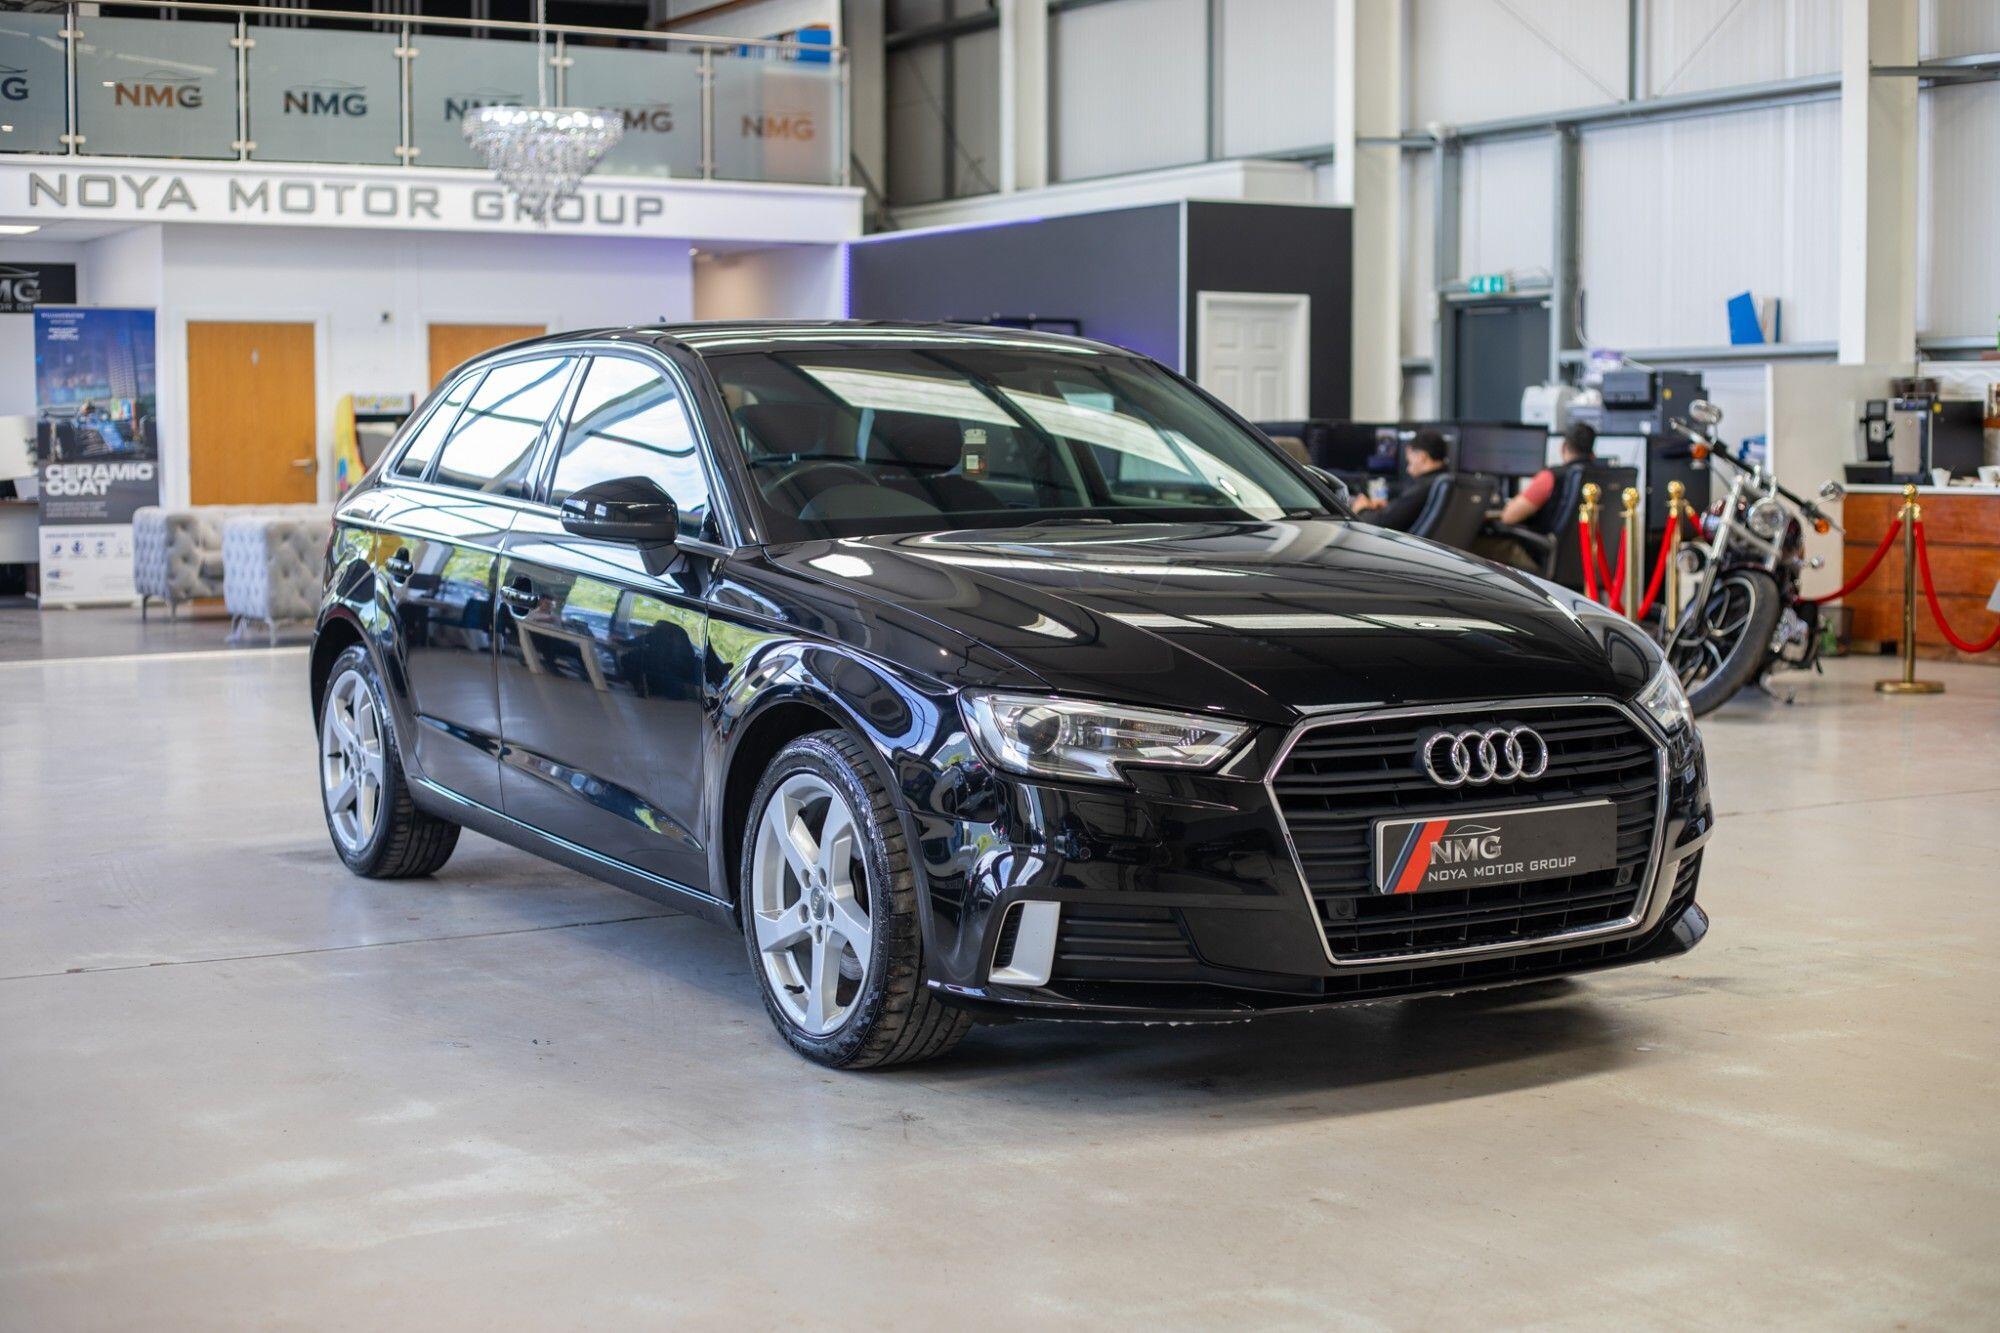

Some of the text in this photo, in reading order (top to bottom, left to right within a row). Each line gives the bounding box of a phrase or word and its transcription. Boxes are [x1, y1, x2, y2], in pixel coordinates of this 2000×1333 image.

[115, 83, 203, 108] NMG
[283, 89, 368, 117] NMG
[602, 108, 674, 133] MG
[742, 115, 815, 141] NMG
[28, 171, 197, 211] NOYA
[228, 178, 442, 219] MOTOR
[45, 463, 154, 481] CERAMIC
[45, 479, 112, 496] COAT
[1429, 835, 1502, 865] NMG
[1428, 855, 1577, 882] NOYA MOTOR GROUP
